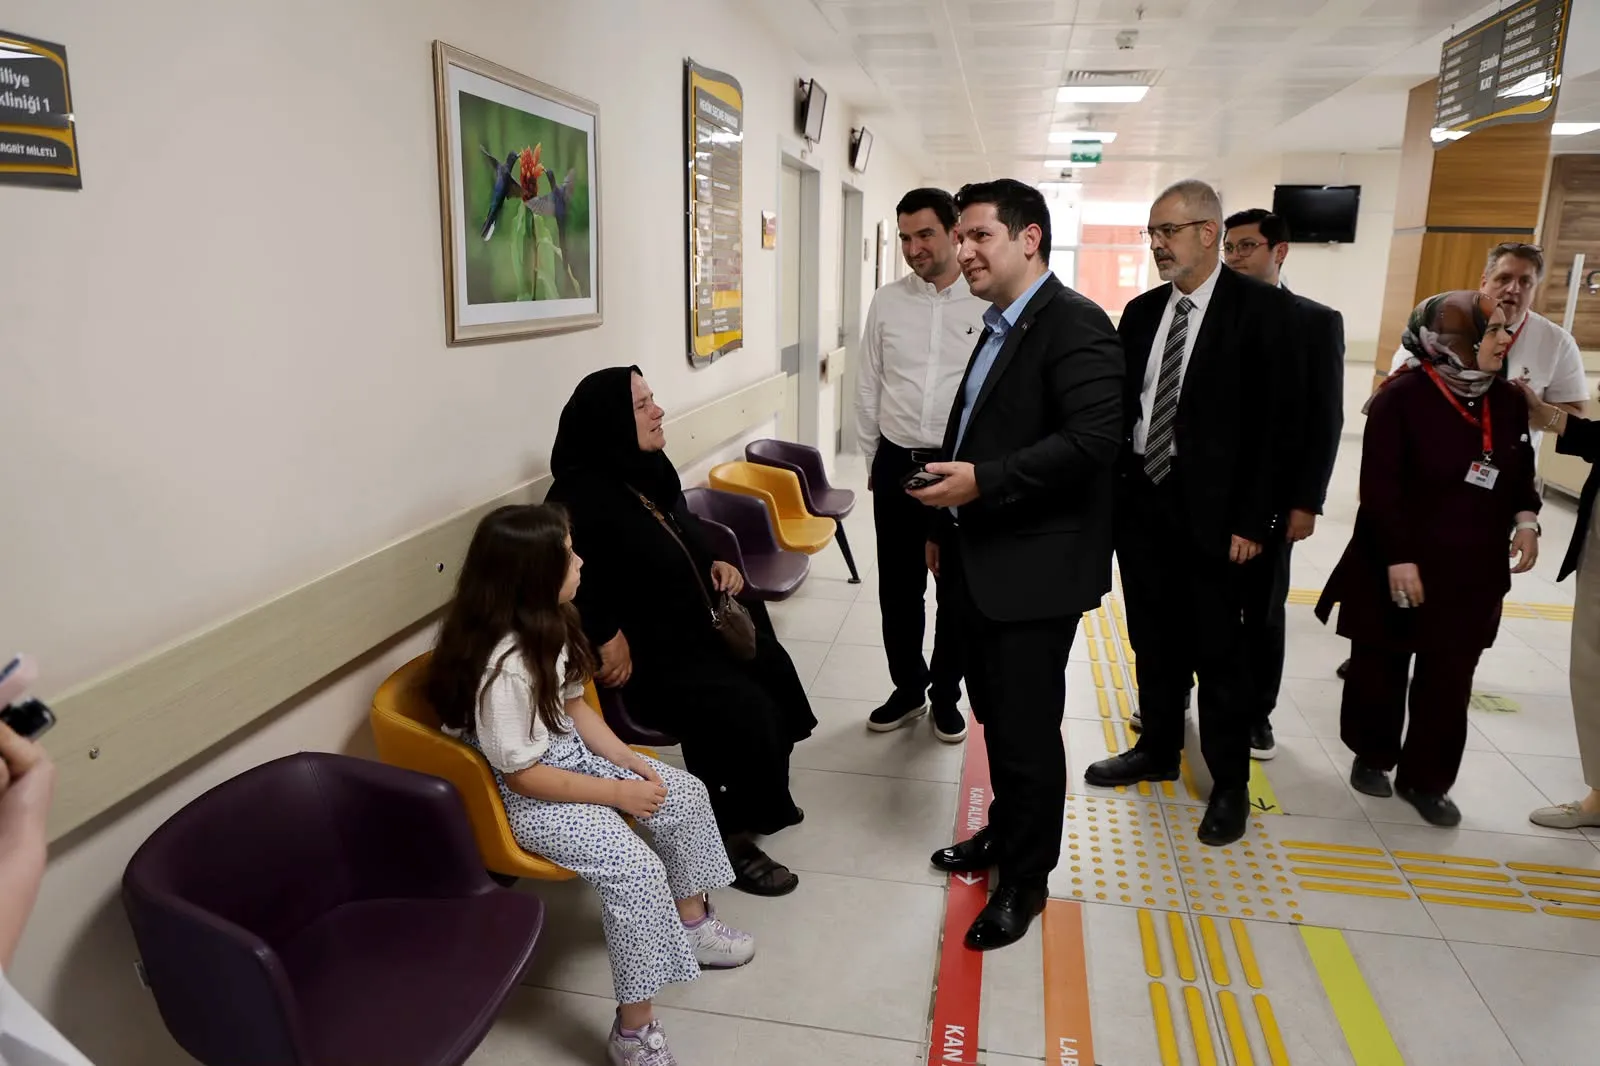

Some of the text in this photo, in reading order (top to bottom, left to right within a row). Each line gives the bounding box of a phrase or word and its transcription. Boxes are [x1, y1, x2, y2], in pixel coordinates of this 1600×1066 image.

[1480, 76, 1493, 91] KAT
[43, 97, 50, 113] 1
[969, 787, 985, 805] KAN
[943, 1024, 965, 1062] KAN
